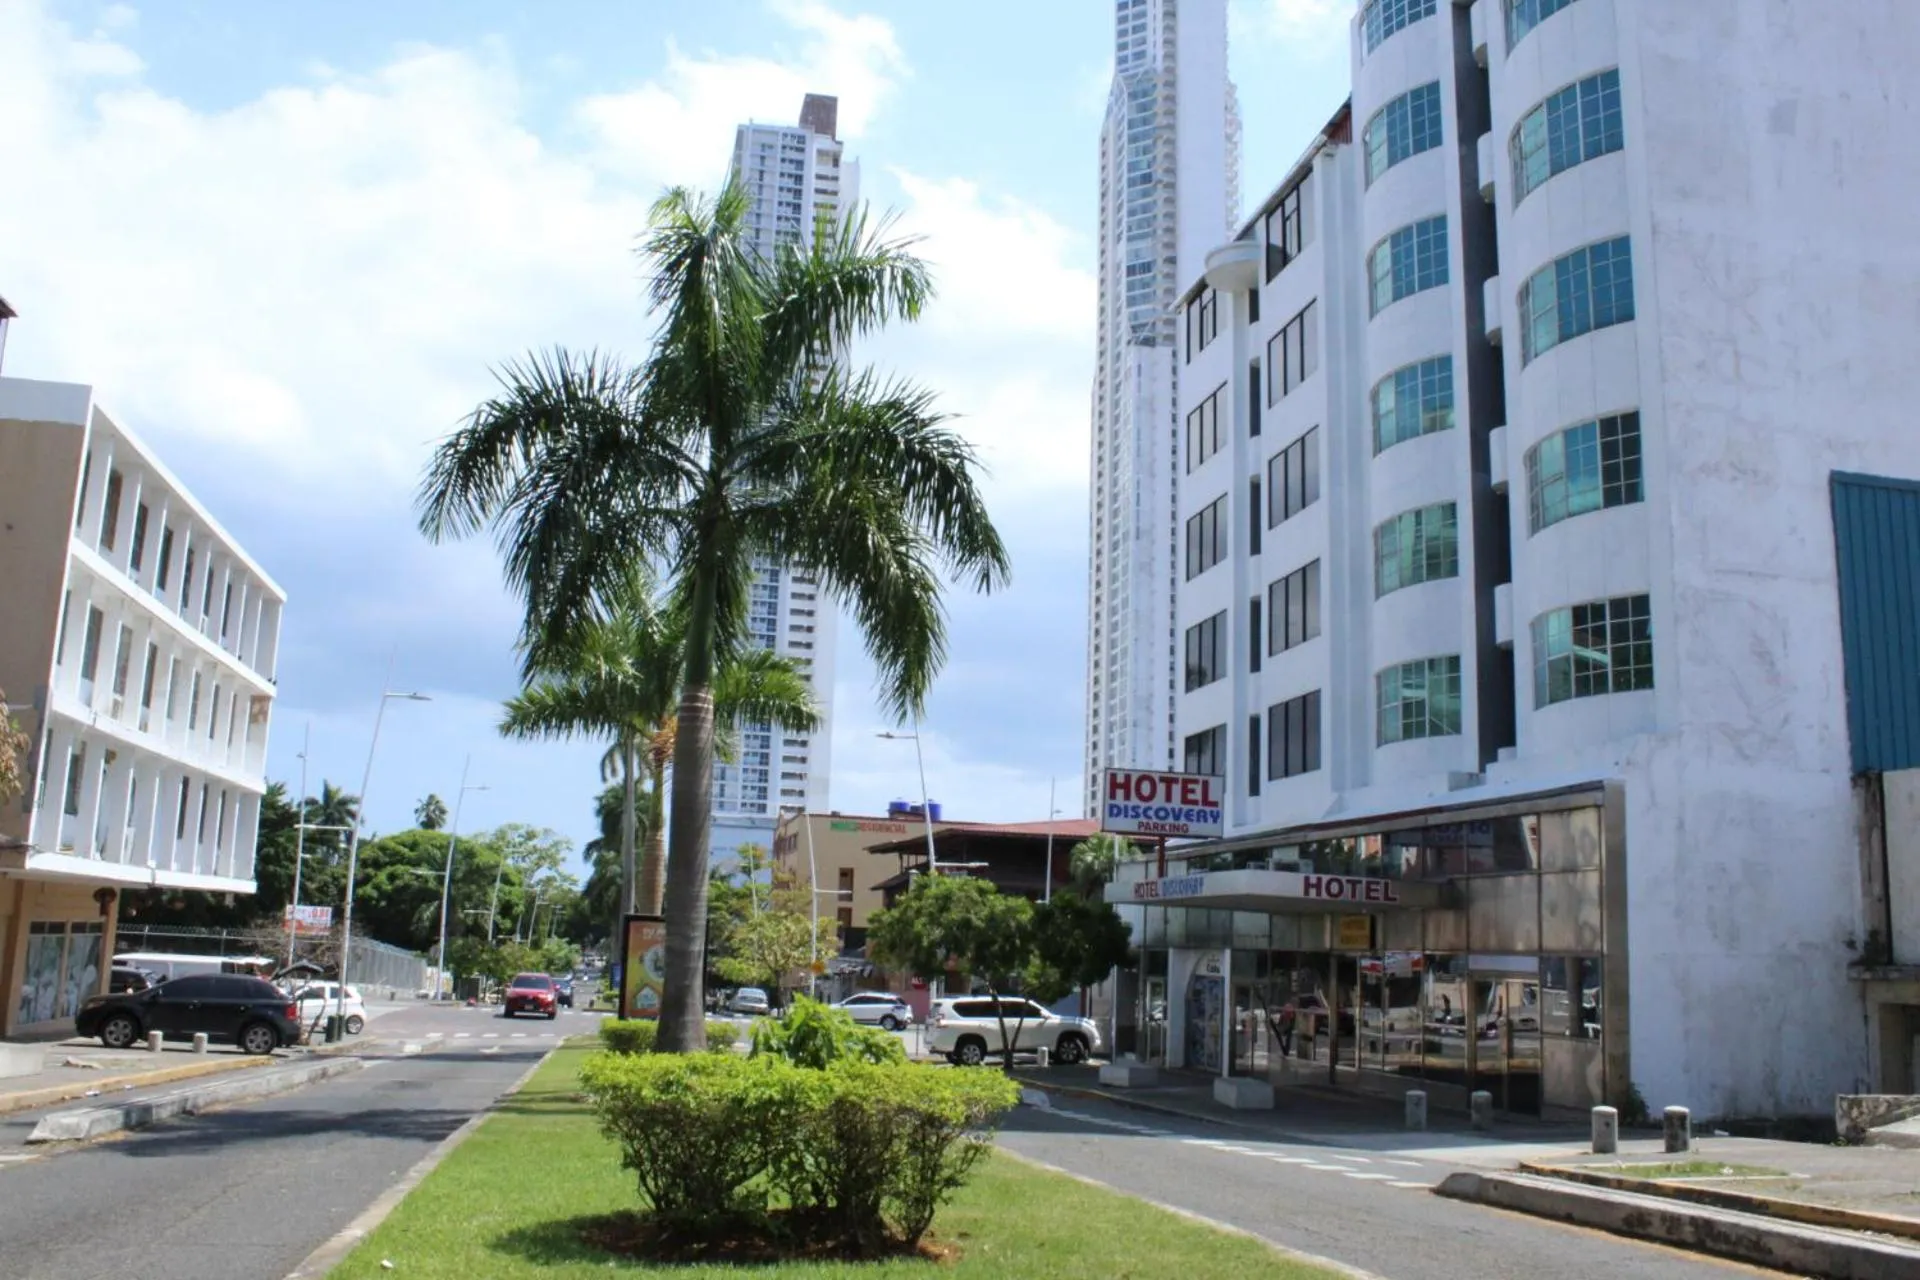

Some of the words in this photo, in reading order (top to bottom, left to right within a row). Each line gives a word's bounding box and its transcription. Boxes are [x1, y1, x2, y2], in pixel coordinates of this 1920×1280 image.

[1109, 772, 1219, 807] HOTEL
[1108, 803, 1221, 824] DISCOVERY
[1137, 820, 1190, 834] PARKING
[1134, 881, 1160, 898] HOTEL
[1303, 876, 1397, 901] HOTEL
